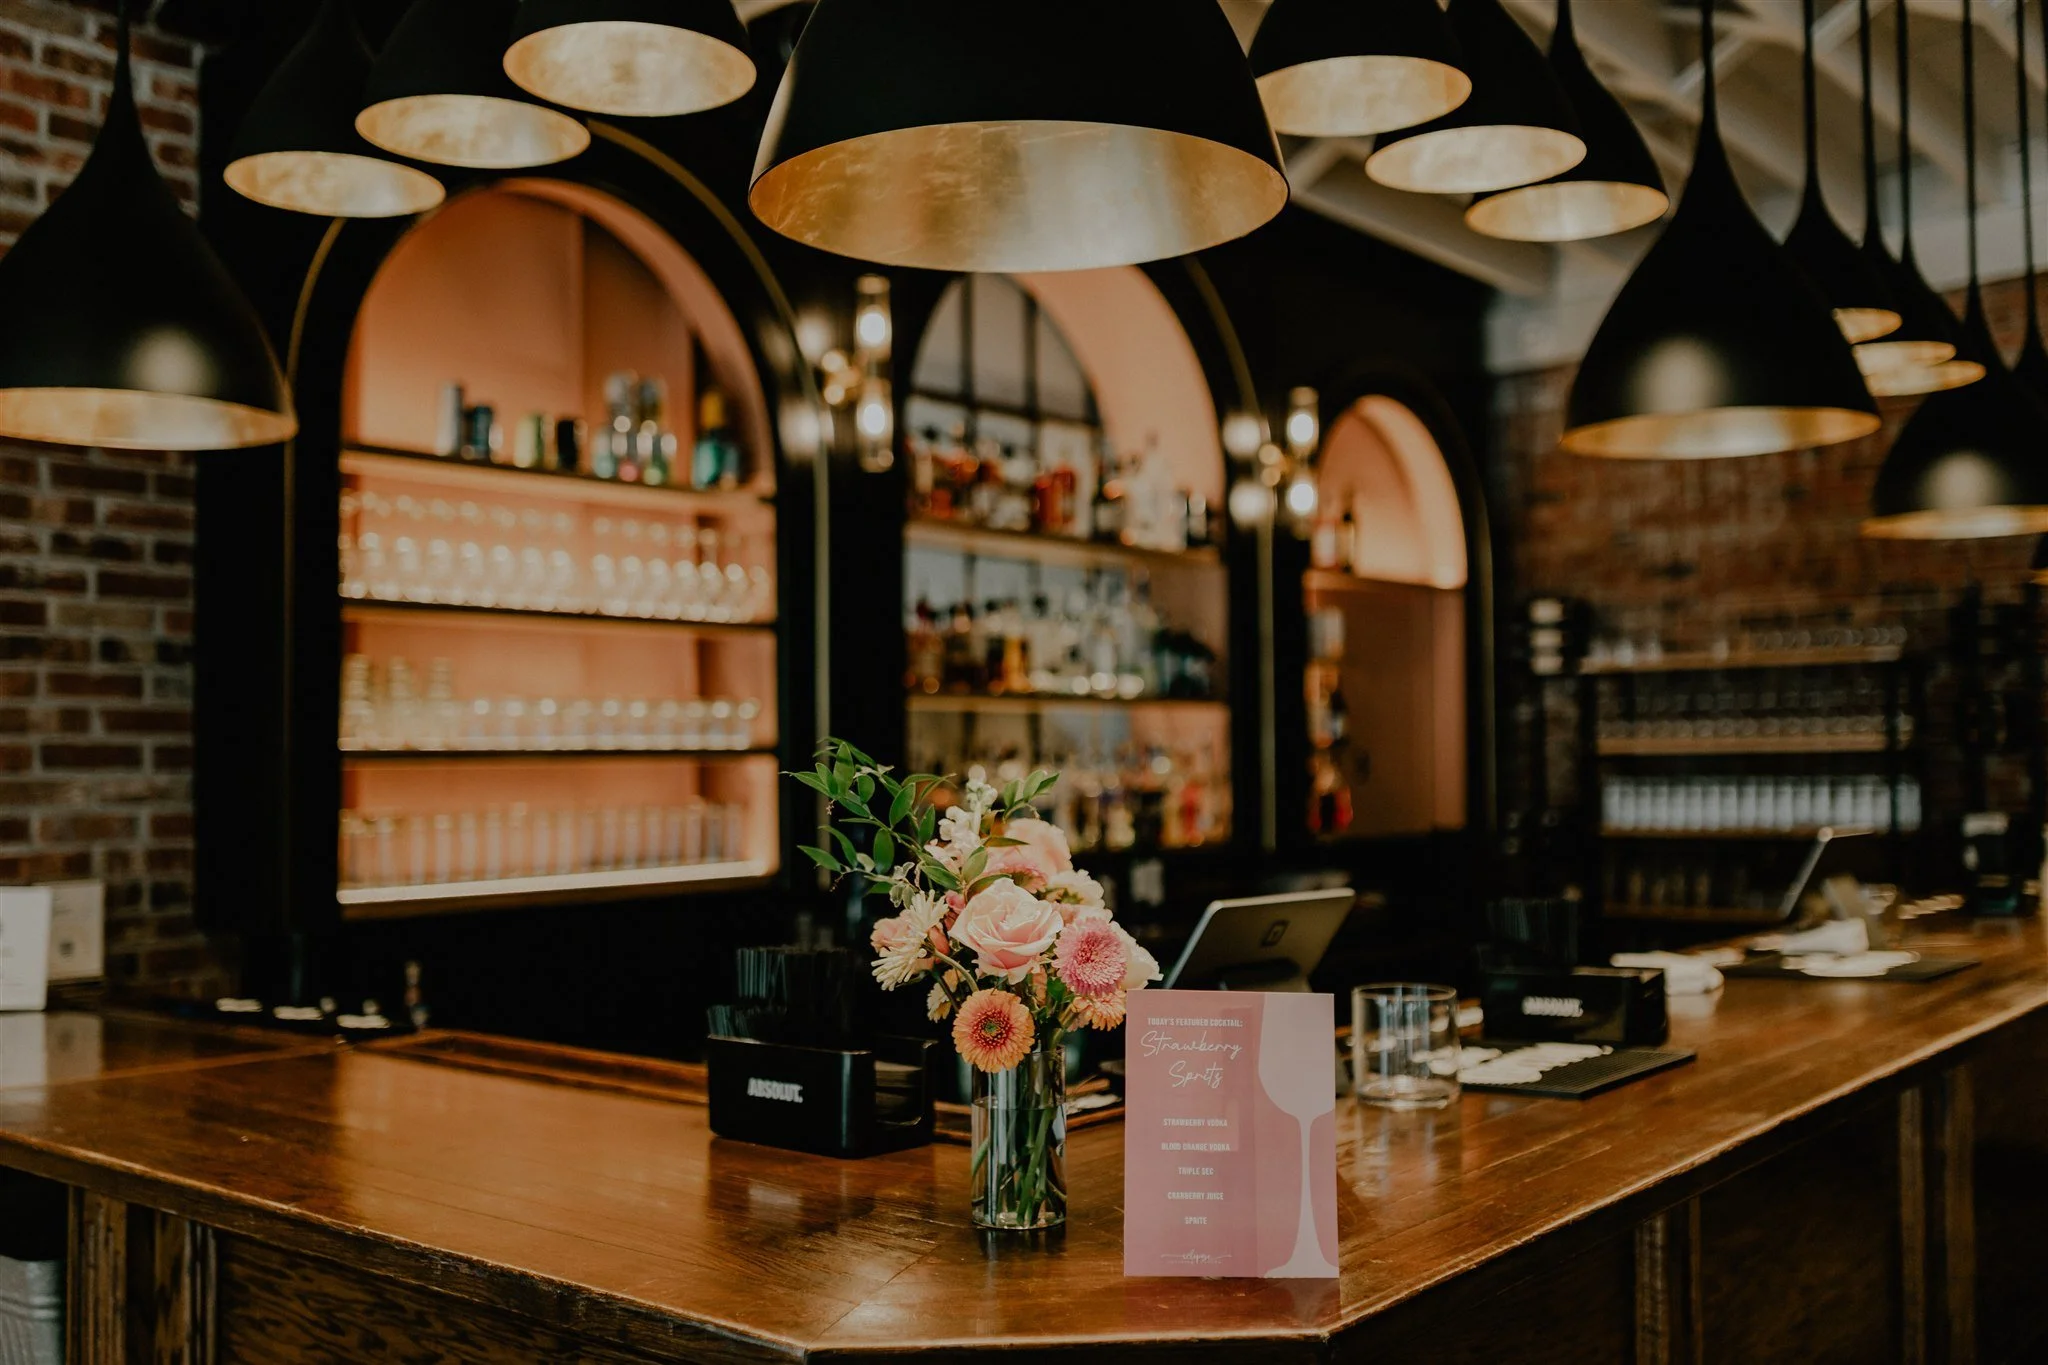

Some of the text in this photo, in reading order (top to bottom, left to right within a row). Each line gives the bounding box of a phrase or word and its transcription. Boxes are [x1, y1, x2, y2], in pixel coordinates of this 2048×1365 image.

[1176, 1018, 1208, 1027] FEATURED
[1140, 1030, 1243, 1060] Strawberry
[1168, 1060, 1224, 1089] Spritz
[1163, 1118, 1228, 1127] STRAWBERRY VODKA
[1161, 1142, 1231, 1151] BLOOD ORANGE VODKA
[1177, 1166, 1215, 1176] TRIPLE SEC
[1167, 1191, 1224, 1201] CRANBERRY JUICE
[1184, 1216, 1208, 1225] SPRITE
